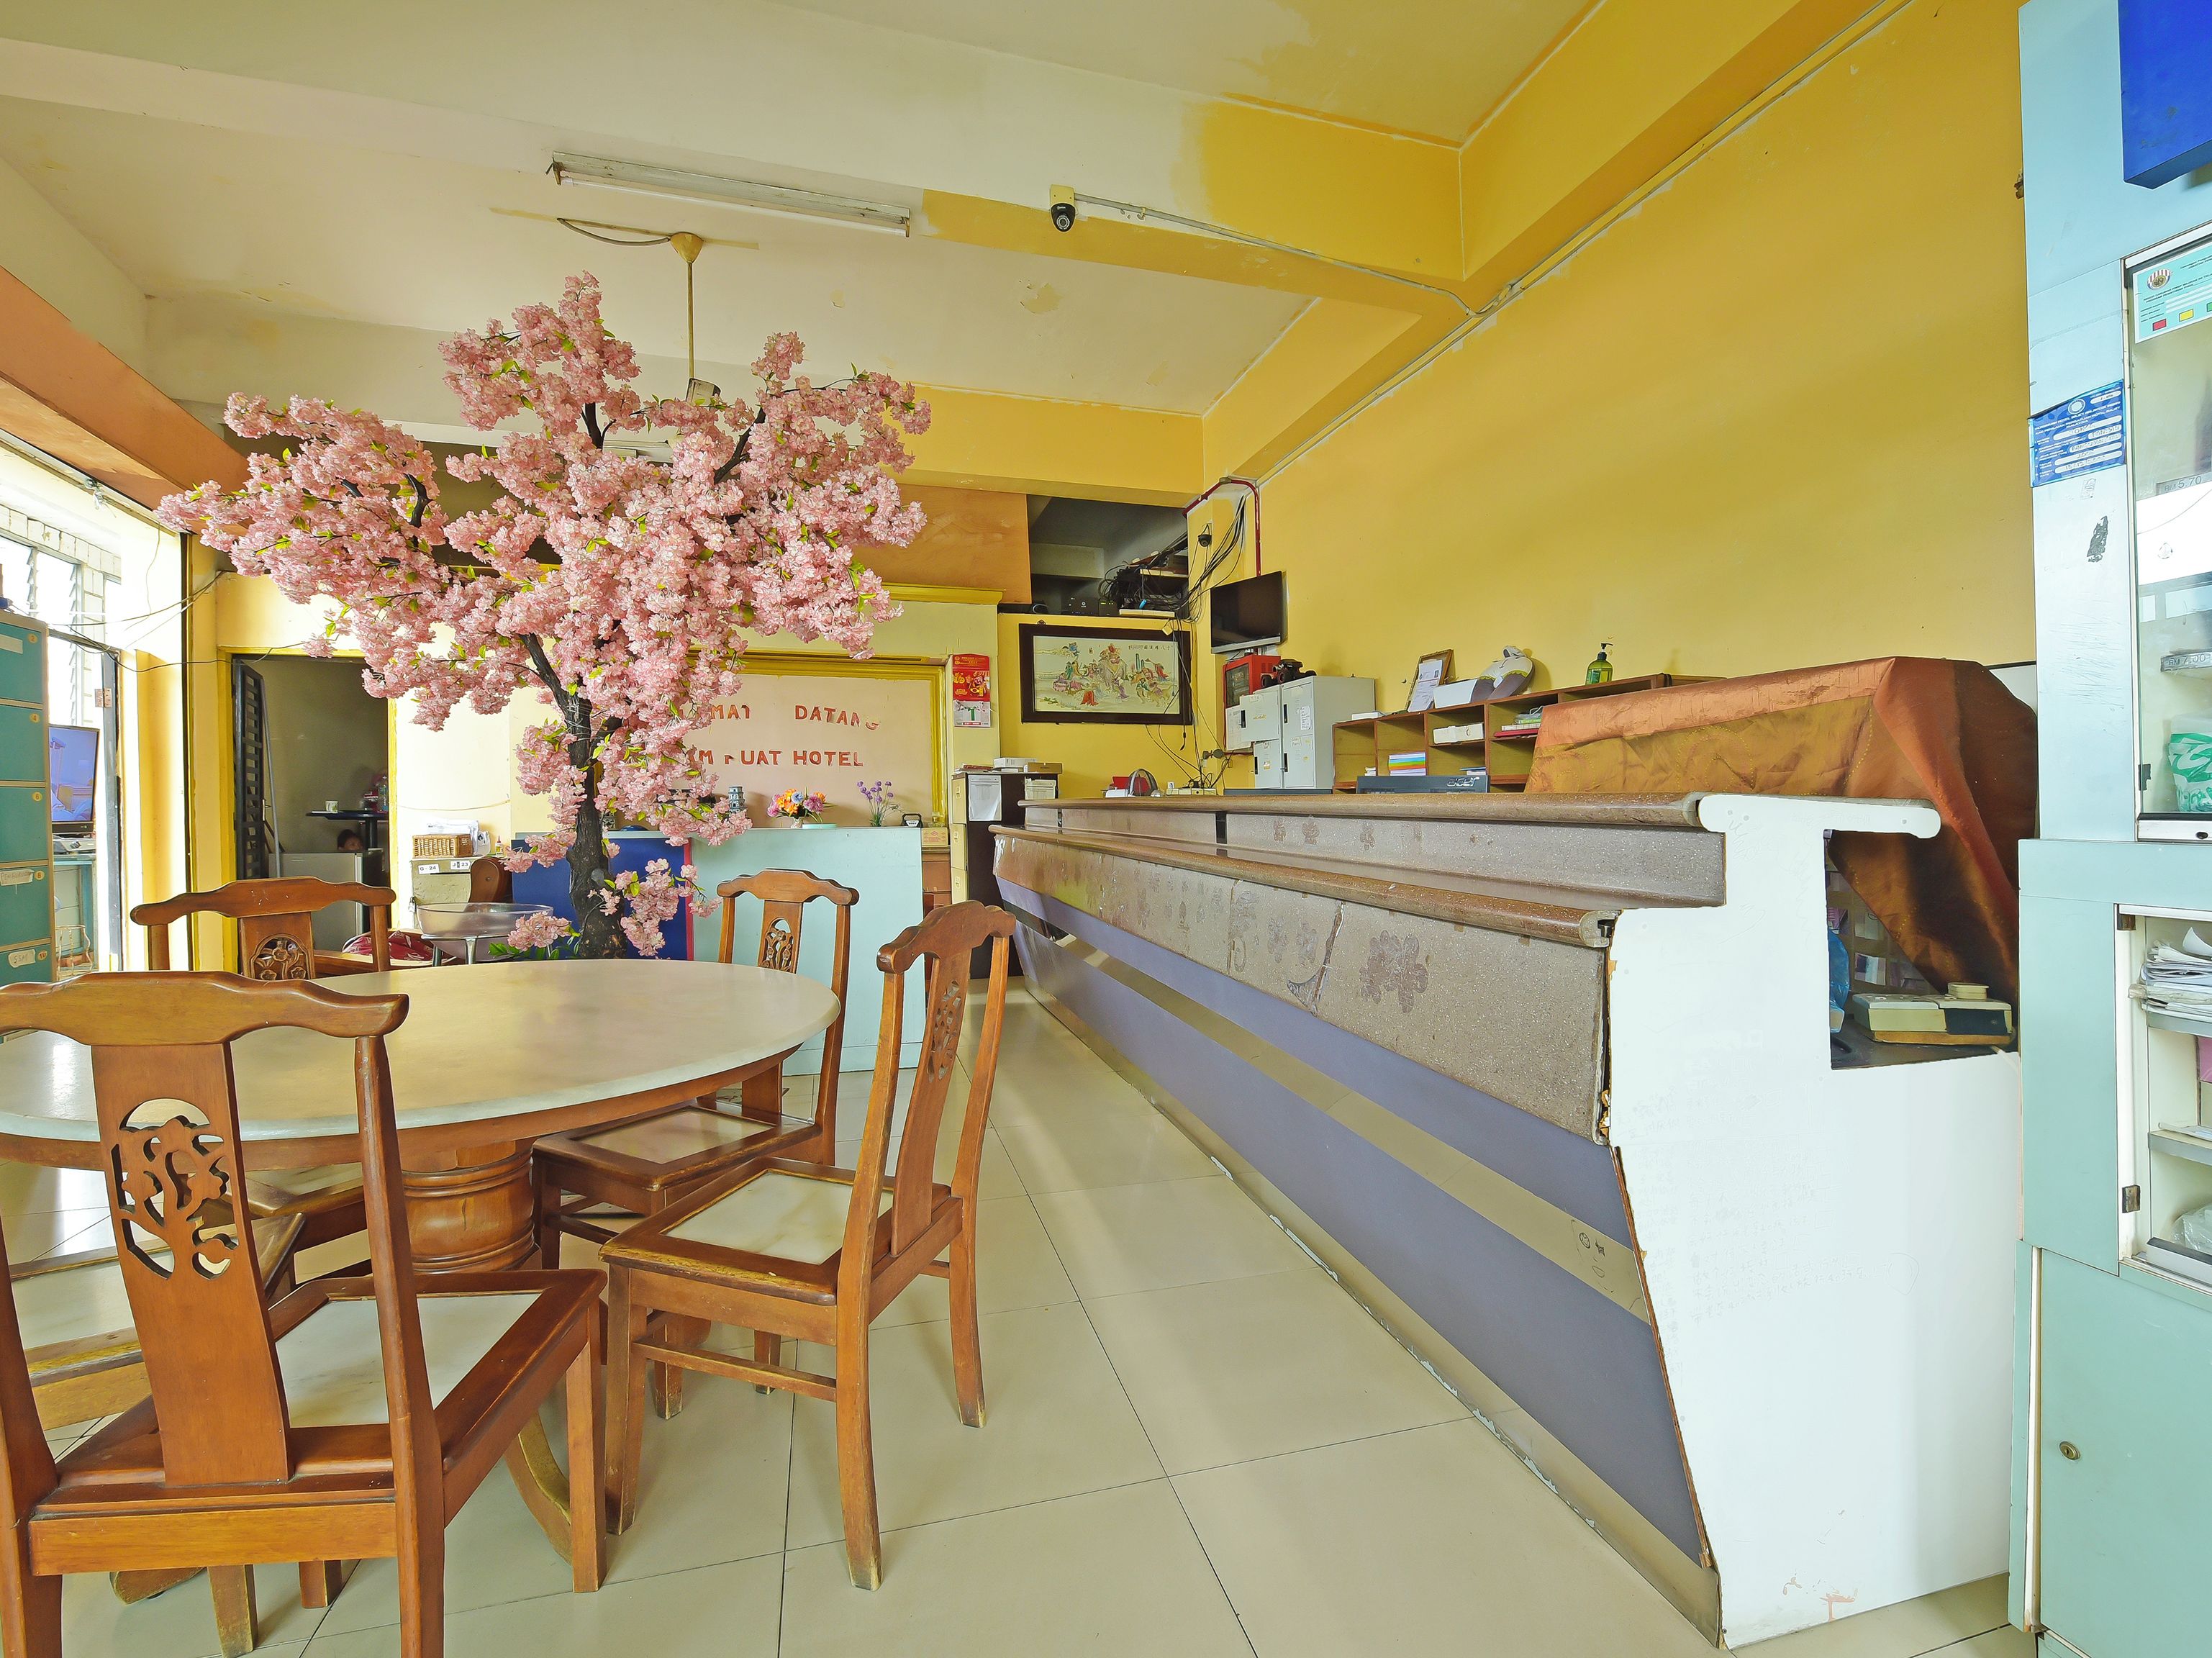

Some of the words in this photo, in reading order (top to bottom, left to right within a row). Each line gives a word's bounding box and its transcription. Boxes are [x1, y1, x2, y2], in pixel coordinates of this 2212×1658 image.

[2177, 476, 2202, 489] 5.70
[793, 750, 864, 766] HOTEL
[1446, 776, 1480, 787] acer
